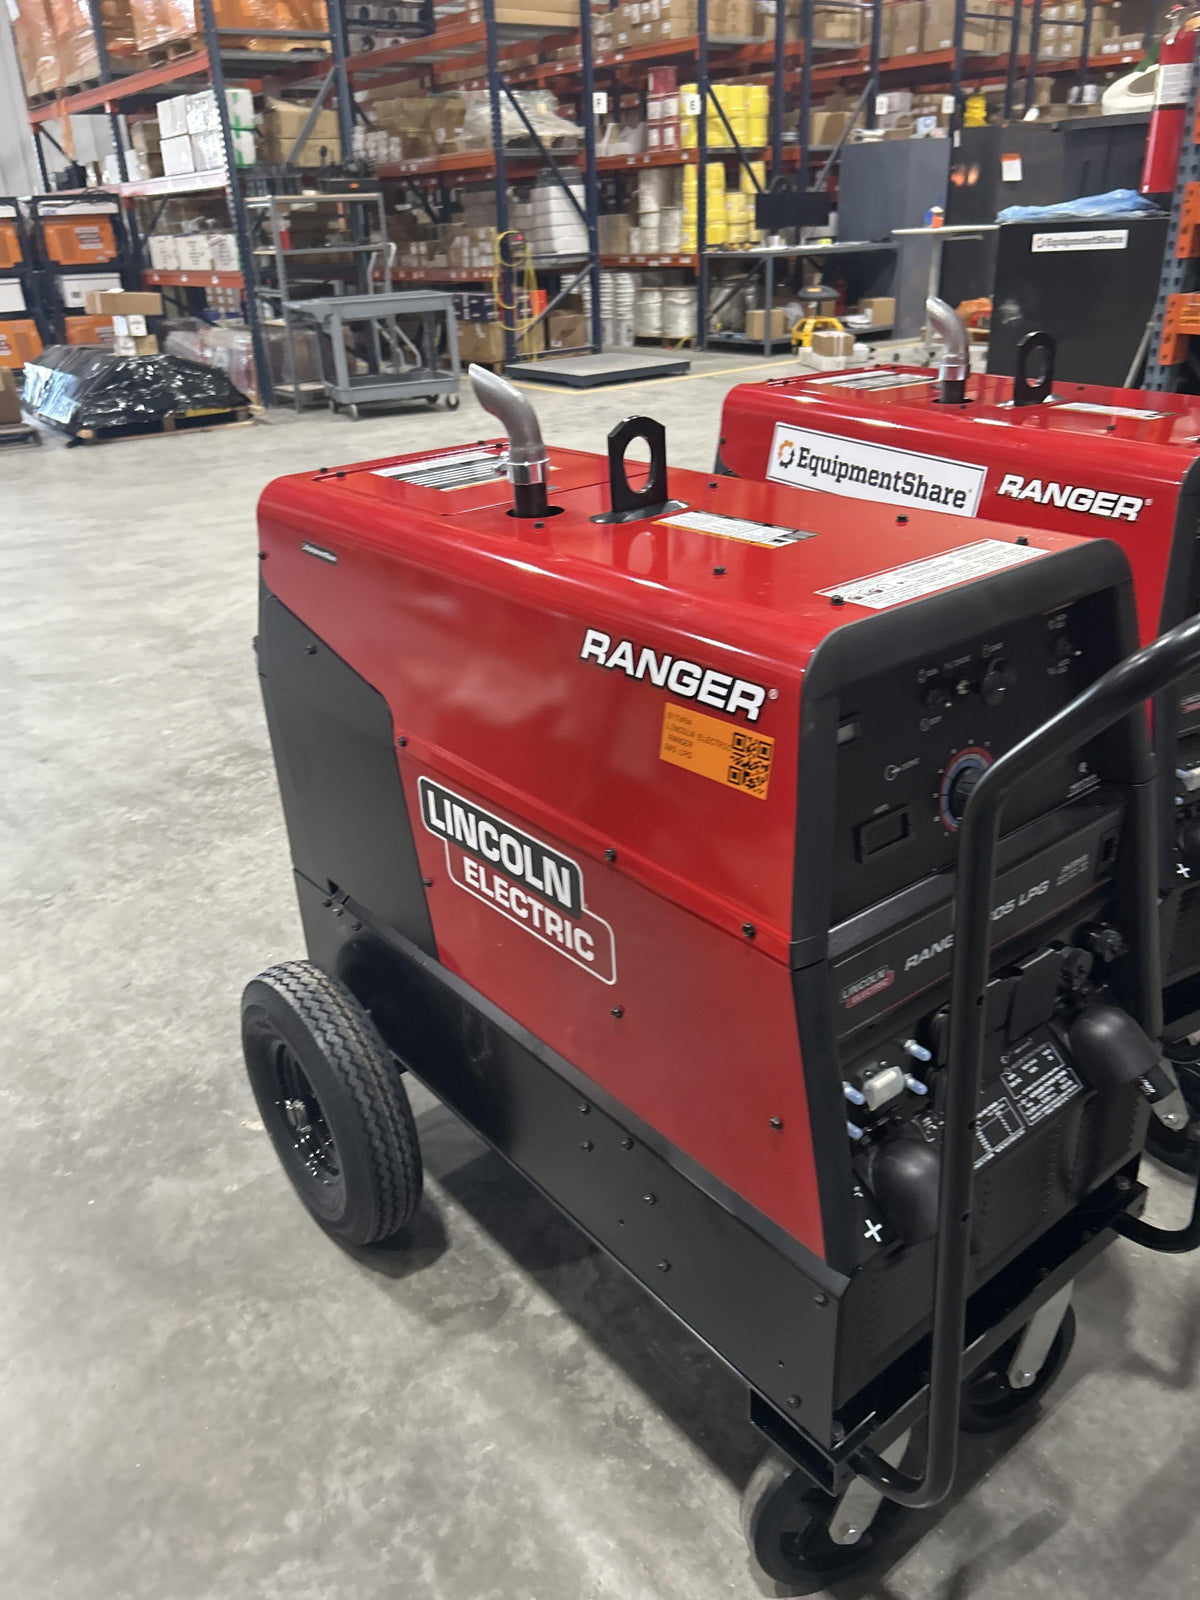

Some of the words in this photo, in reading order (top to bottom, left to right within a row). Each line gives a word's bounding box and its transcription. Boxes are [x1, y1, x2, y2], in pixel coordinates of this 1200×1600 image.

[797, 447, 967, 510] EquipmentShare
[427, 789, 573, 909] LINCOLN
[463, 855, 596, 962] ELECTRIC
[1017, 879, 1052, 908] LPG
